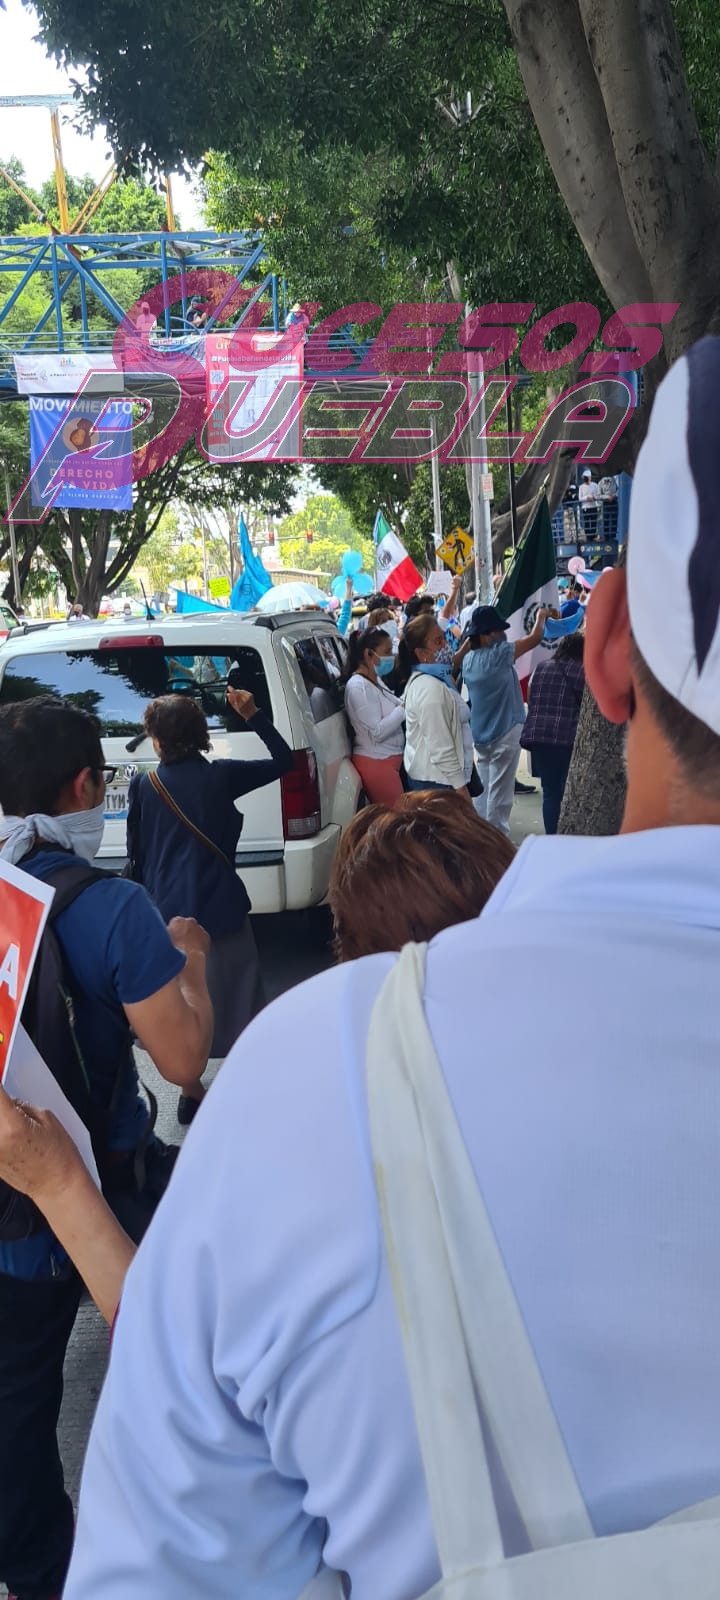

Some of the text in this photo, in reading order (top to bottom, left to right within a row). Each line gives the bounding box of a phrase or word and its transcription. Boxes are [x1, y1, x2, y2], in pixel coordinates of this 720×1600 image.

[29, 397, 133, 415] MOVIMIENTO
[49, 469, 114, 479] DERECHO
[82, 481, 117, 491] VIDA
